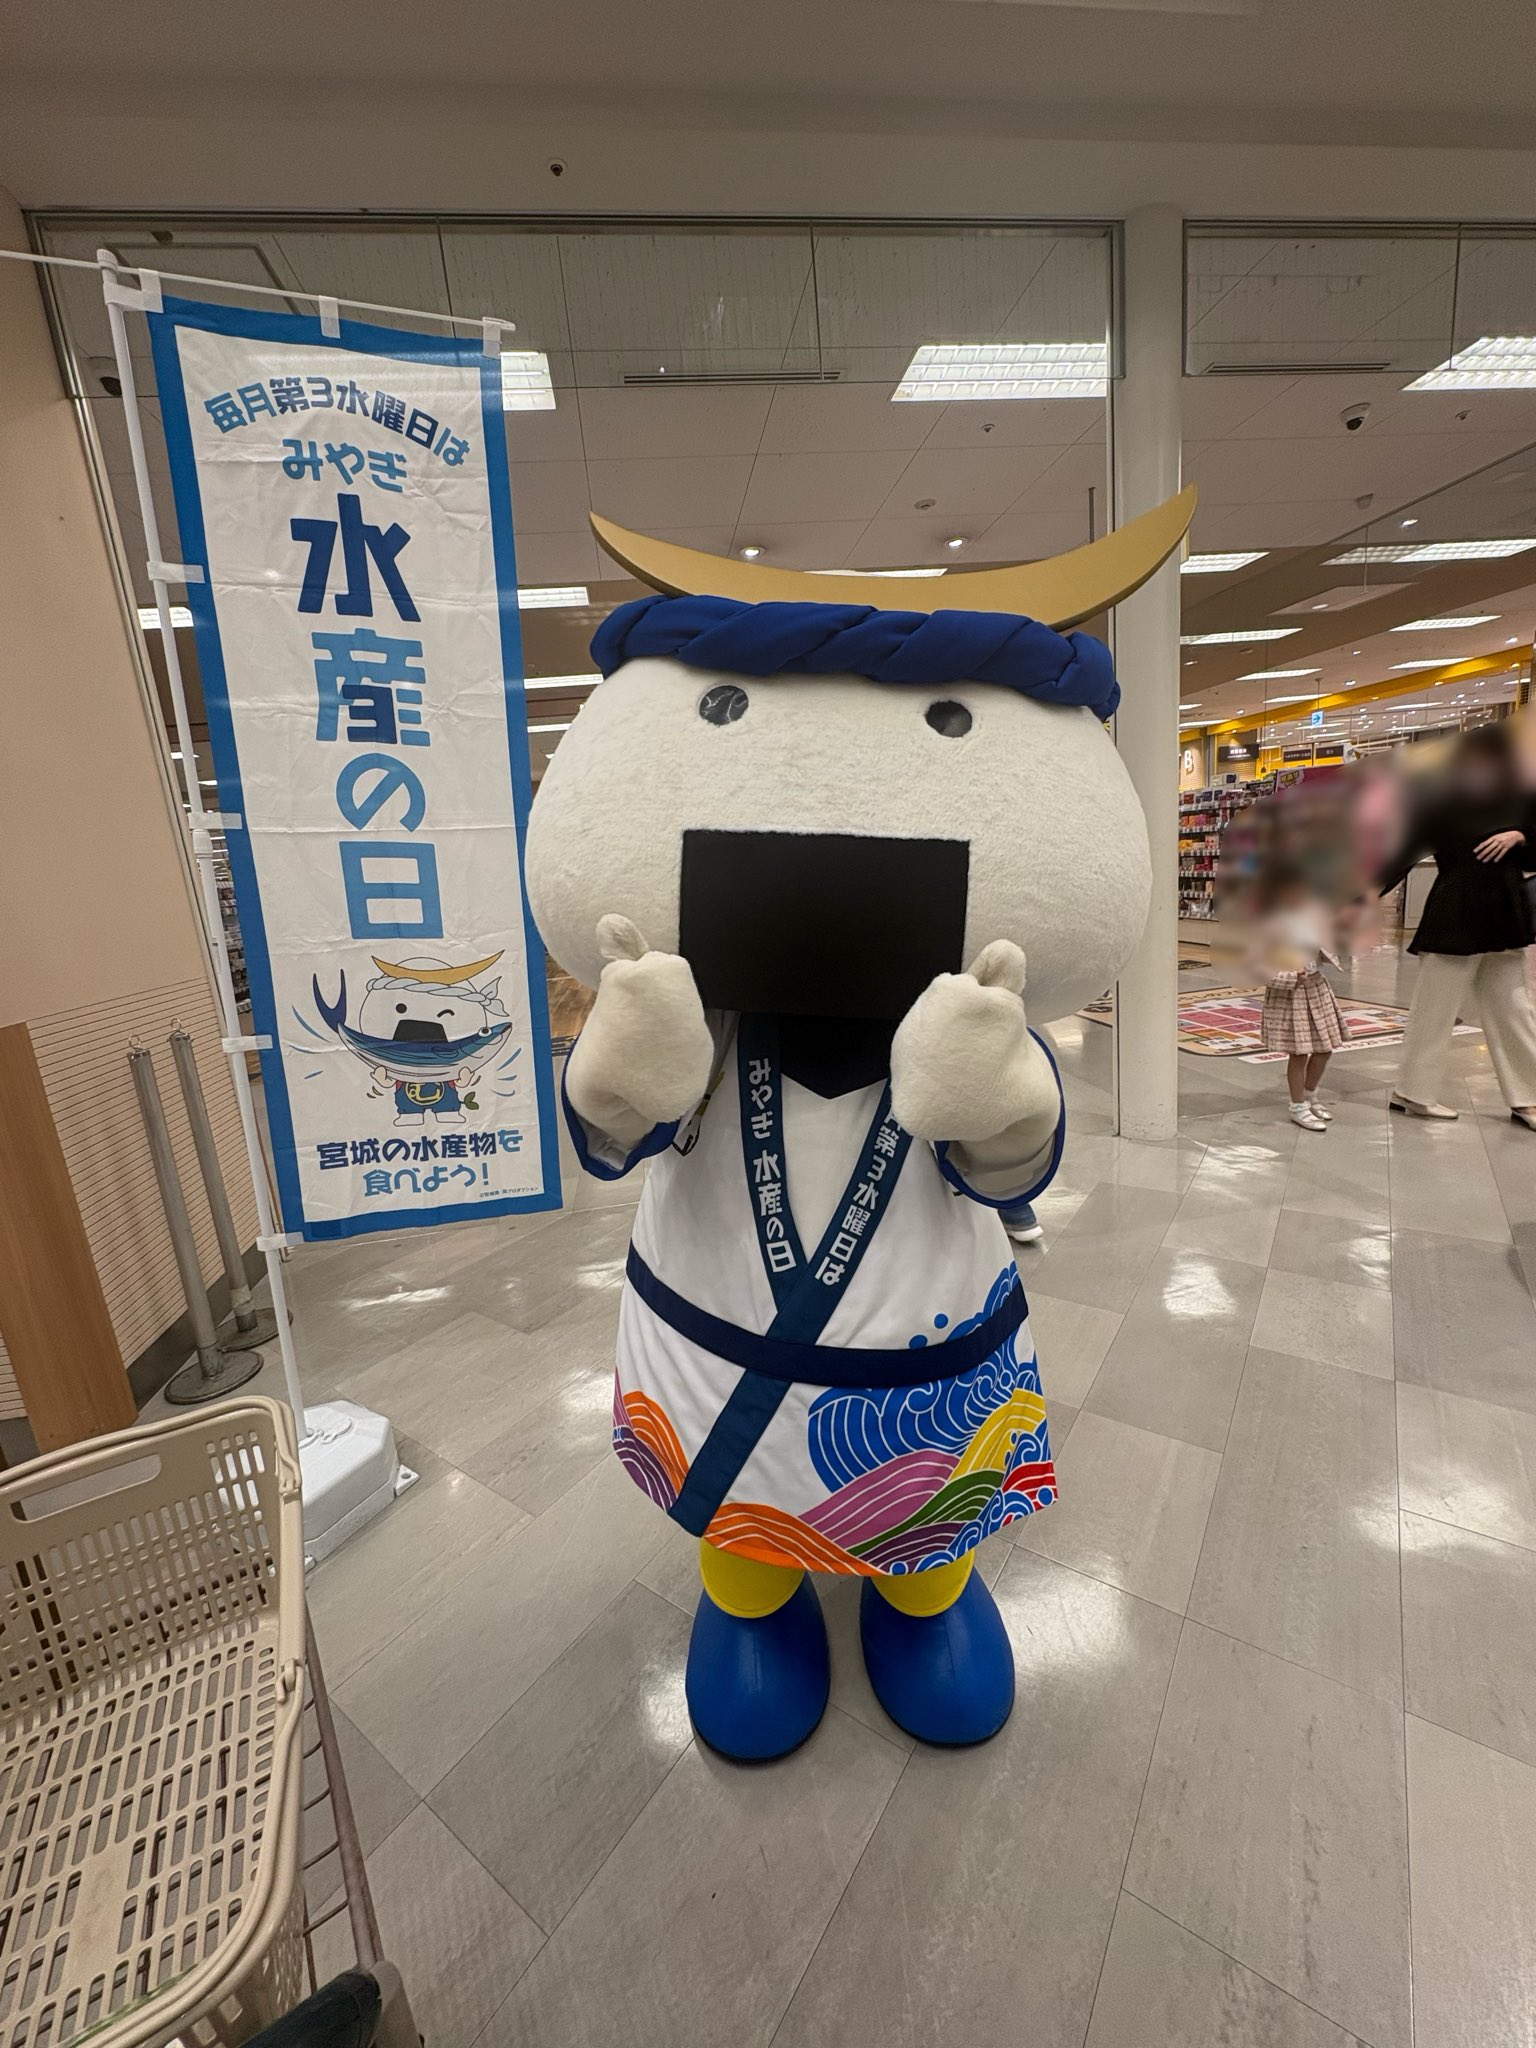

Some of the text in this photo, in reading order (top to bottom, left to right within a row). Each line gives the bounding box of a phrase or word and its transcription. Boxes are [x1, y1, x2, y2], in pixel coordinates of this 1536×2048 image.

[204, 376, 471, 467] 毎月第3水曜日は
[282, 438, 408, 493] みやぎ
[290, 493, 444, 940] 水産の日
[316, 1129, 523, 1171] 宮城の水産物を
[362, 1162, 490, 1198] 食べよう！
[748, 1057, 798, 1274] みやぎ 水産の日
